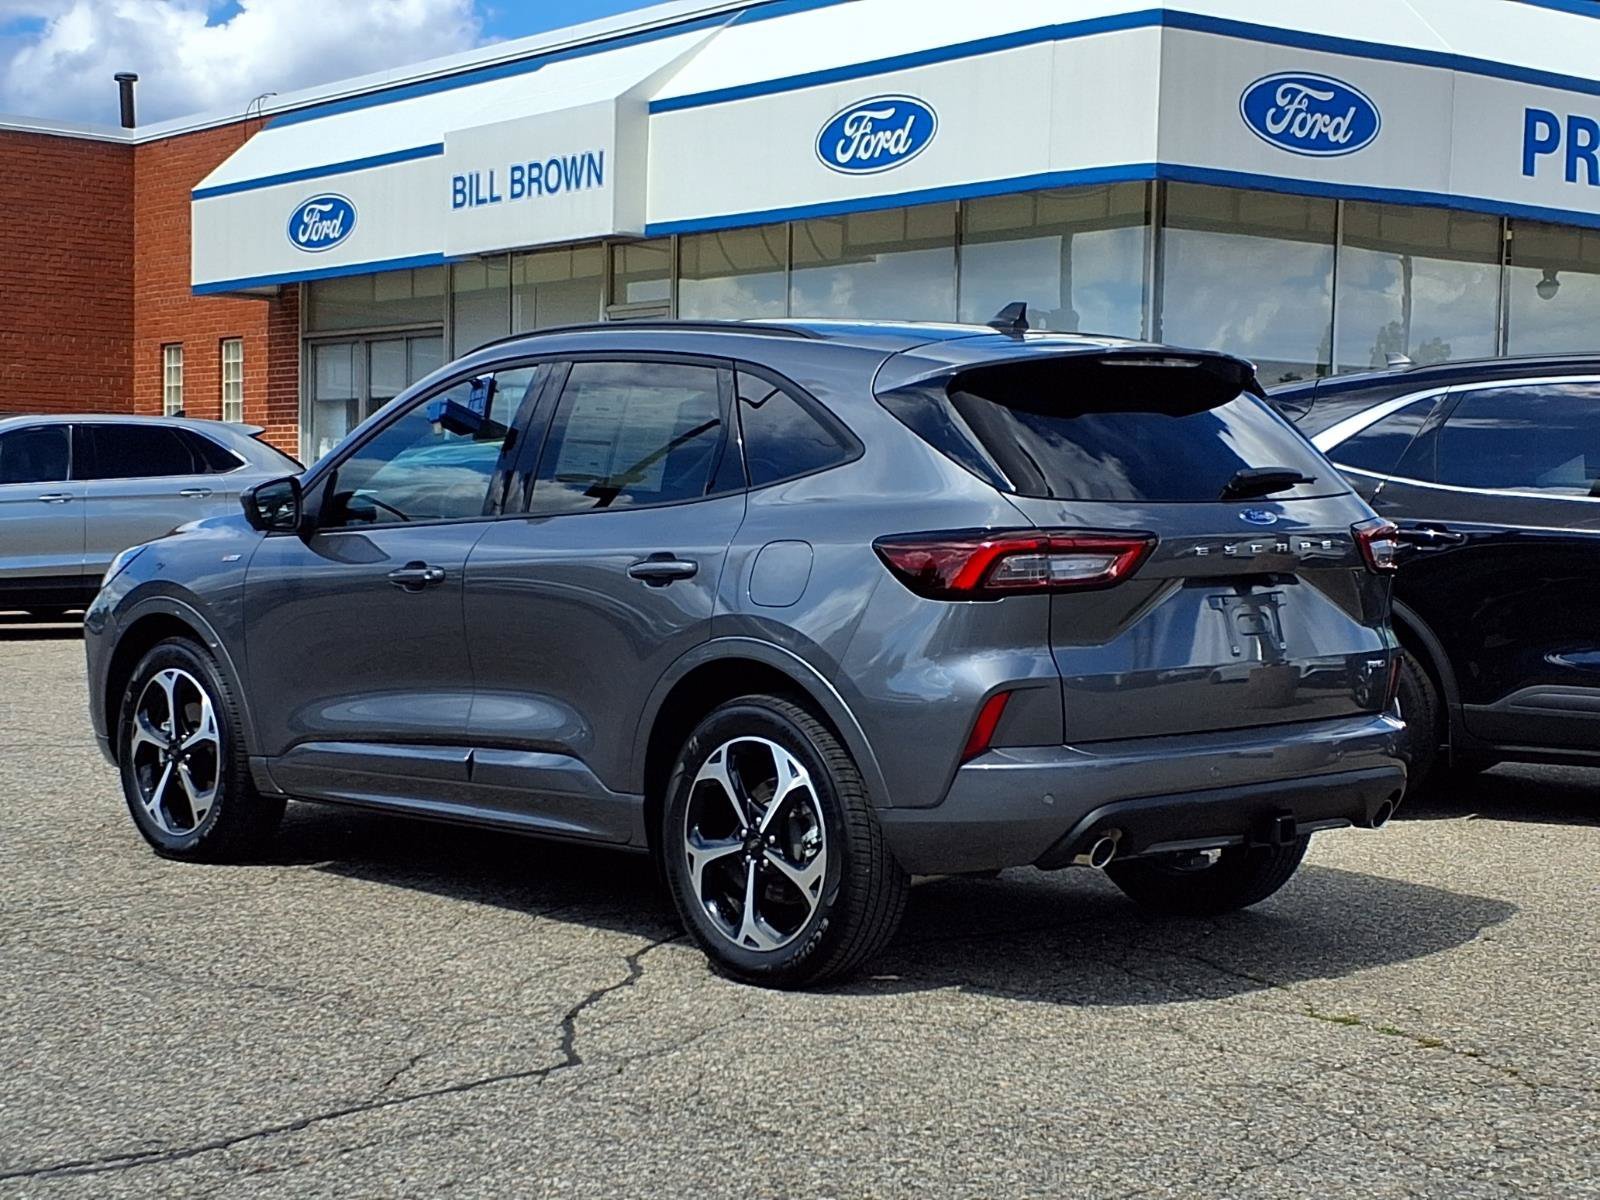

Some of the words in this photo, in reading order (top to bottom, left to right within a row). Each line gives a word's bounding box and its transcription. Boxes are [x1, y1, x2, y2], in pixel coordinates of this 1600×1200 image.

[836, 107, 915, 163] Ford
[1266, 82, 1356, 144] Ford
[1522, 107, 1600, 187] PR
[452, 170, 502, 209] BILL
[510, 150, 604, 200] BROWN
[298, 203, 344, 243] Ford
[1195, 540, 1332, 556] ESCAPE
